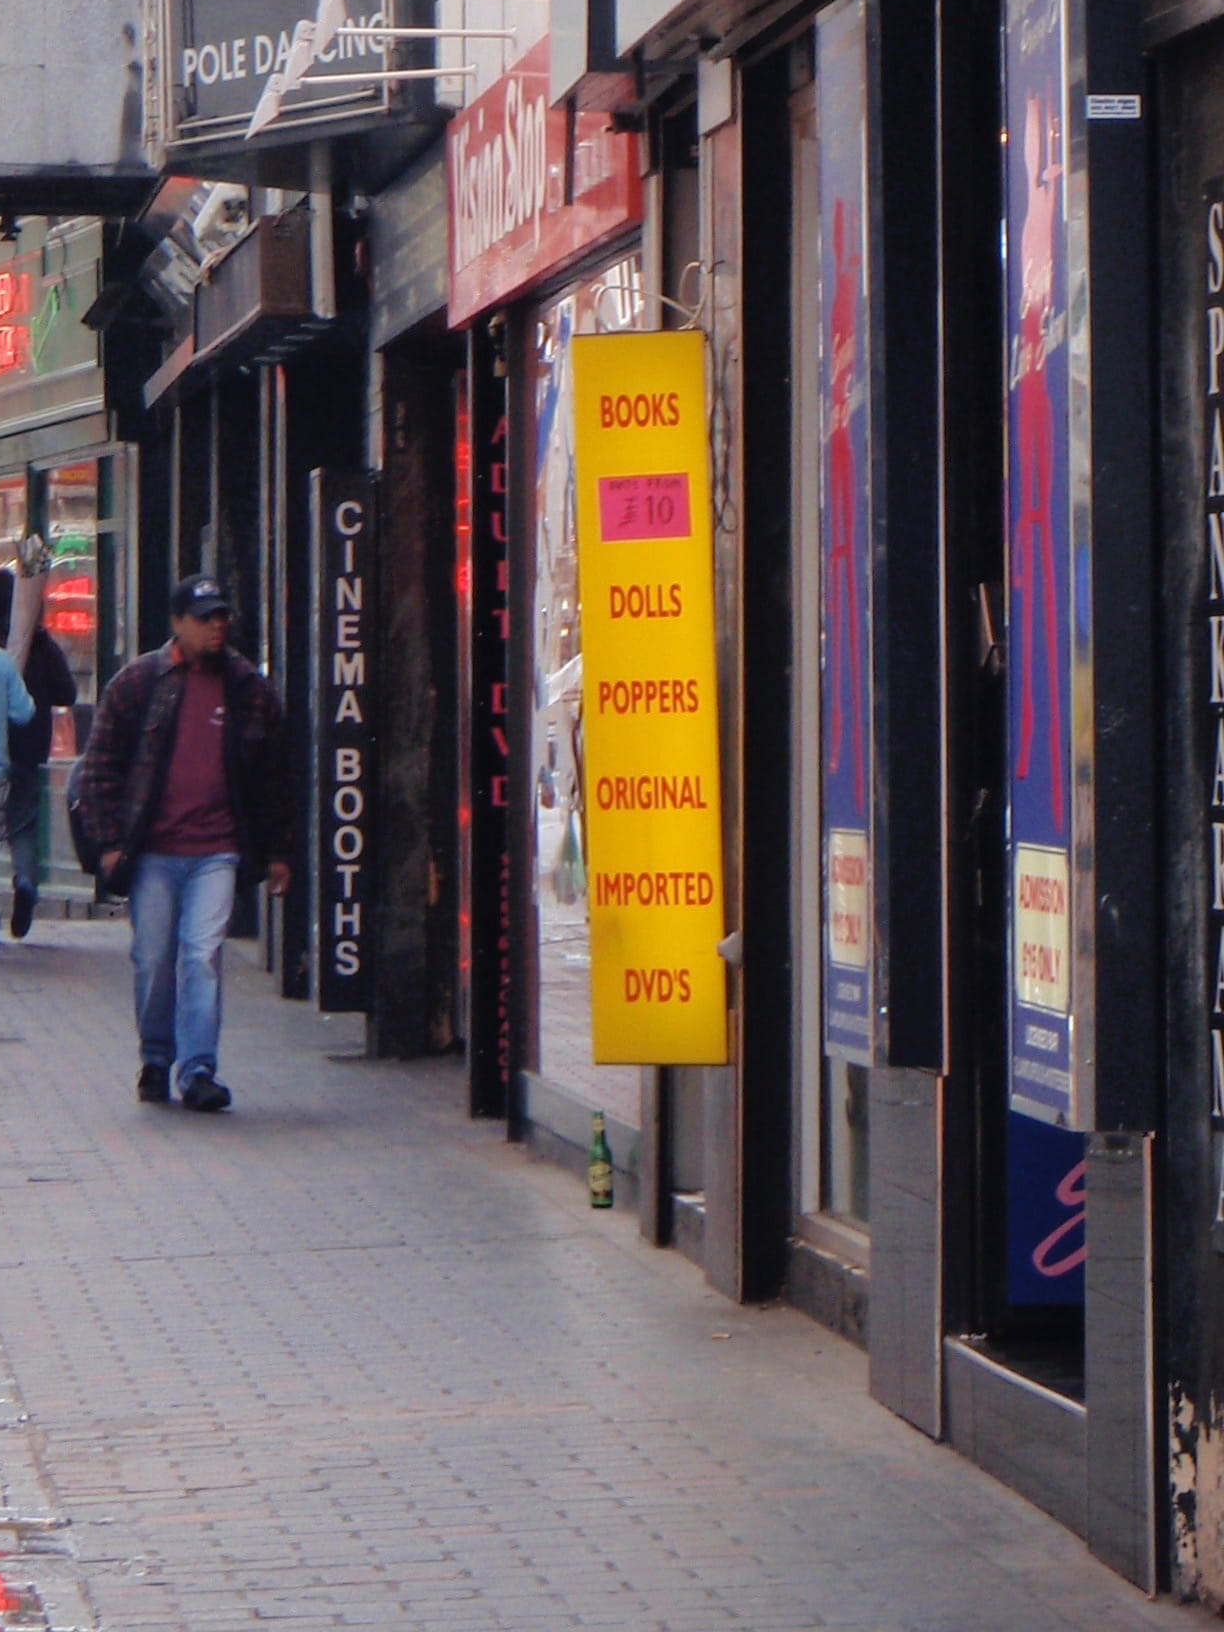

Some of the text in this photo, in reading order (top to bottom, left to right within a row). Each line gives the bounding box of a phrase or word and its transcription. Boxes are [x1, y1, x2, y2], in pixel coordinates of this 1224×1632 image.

[183, 13, 389, 88] POLE DAING
[599, 394, 681, 429] BOOKS
[333, 500, 365, 724] CINEMA
[608, 584, 683, 619] DOLLS
[598, 679, 700, 715] POPPERS
[595, 775, 708, 811] ORIGINAL
[333, 748, 365, 976] BOOTHS
[594, 871, 714, 907] IMPORTED
[623, 968, 692, 1004] DVD'S
